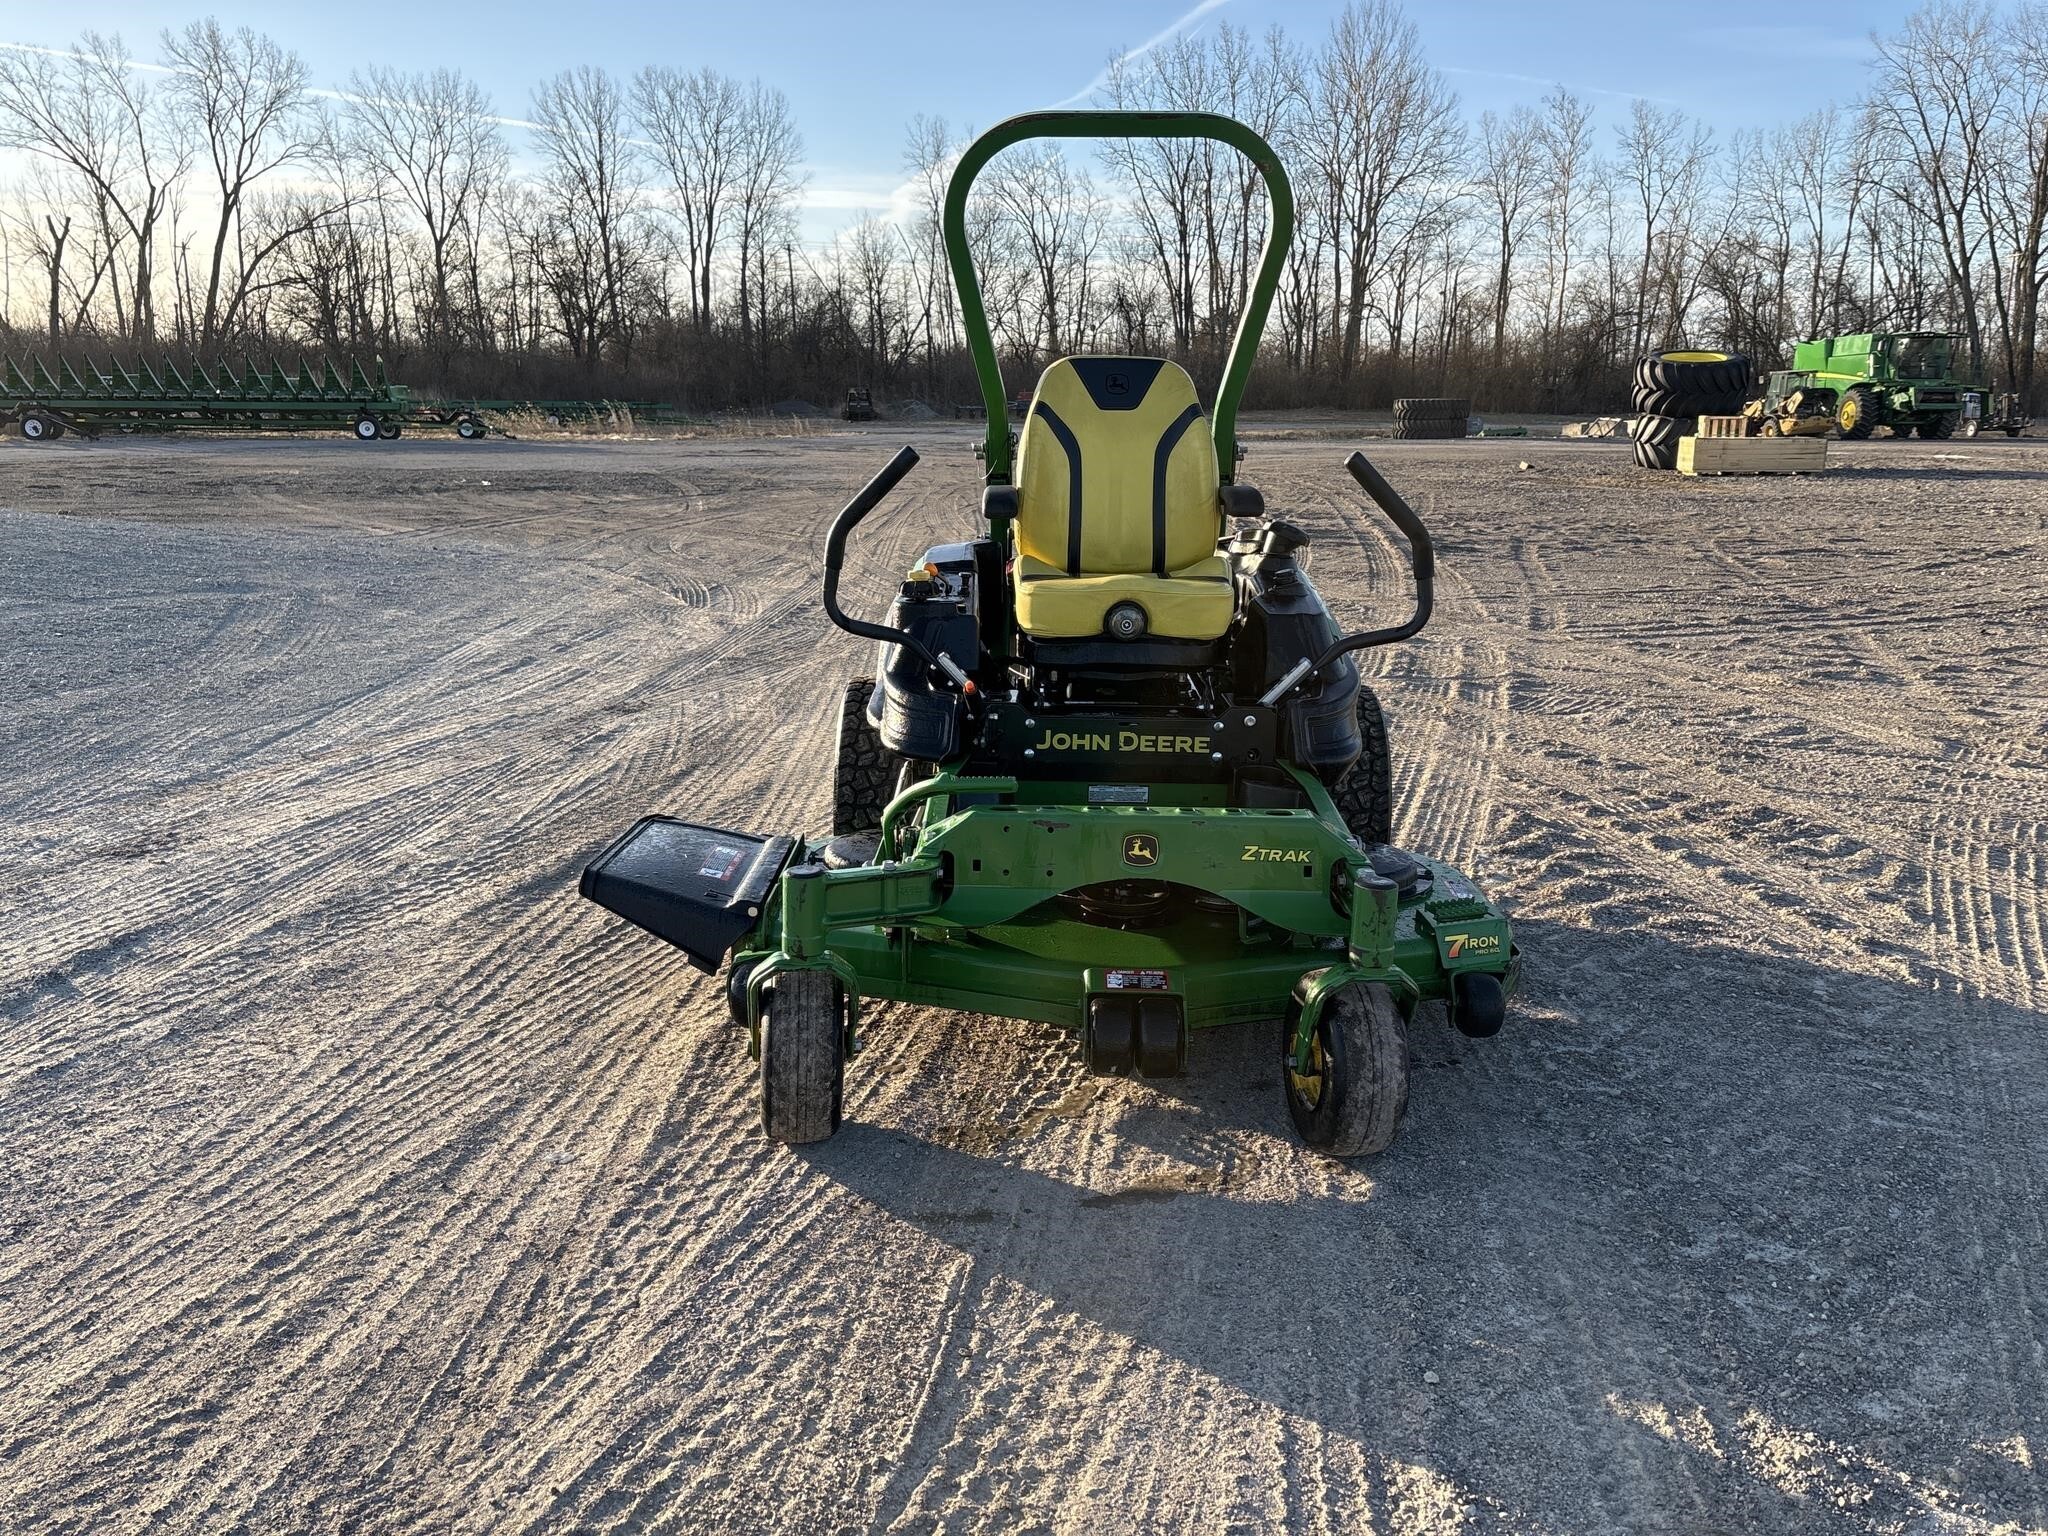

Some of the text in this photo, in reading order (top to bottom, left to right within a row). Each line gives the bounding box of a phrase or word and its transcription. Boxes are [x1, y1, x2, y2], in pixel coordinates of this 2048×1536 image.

[1036, 729, 1211, 754] JOHN DEERE
[1241, 845, 1312, 863] ZTRAK
